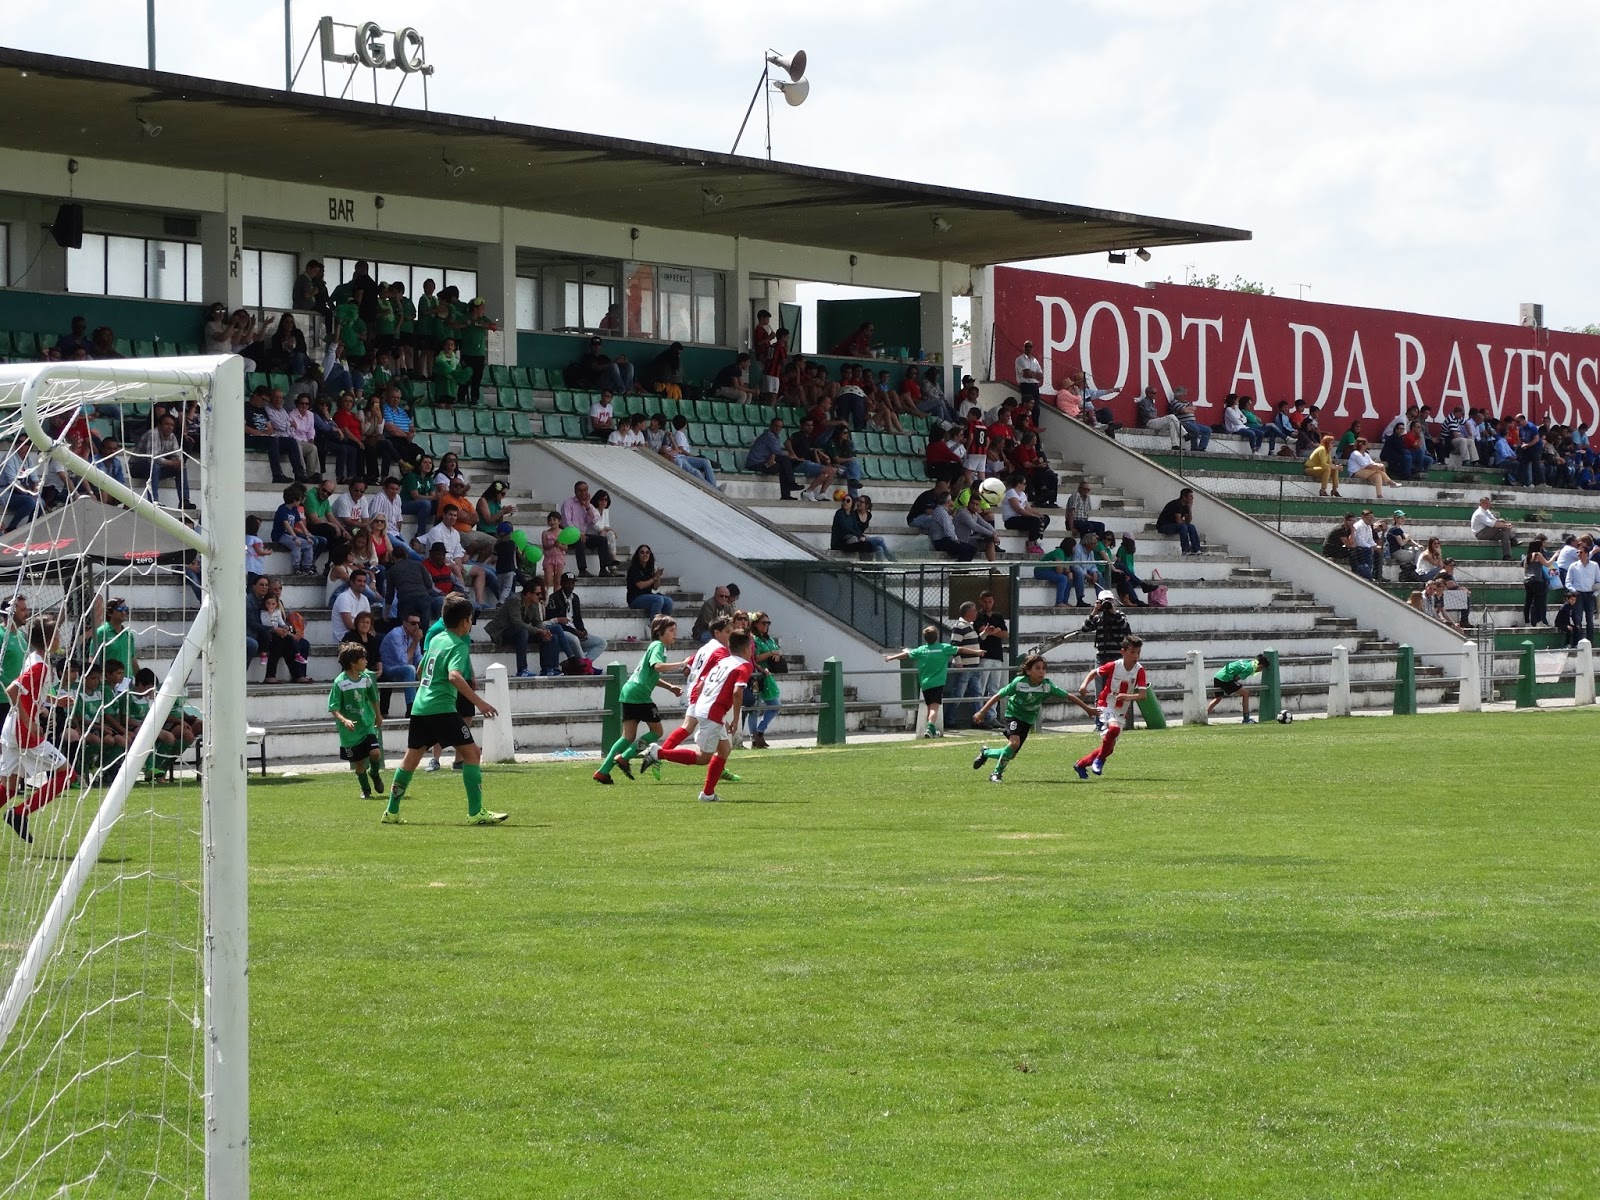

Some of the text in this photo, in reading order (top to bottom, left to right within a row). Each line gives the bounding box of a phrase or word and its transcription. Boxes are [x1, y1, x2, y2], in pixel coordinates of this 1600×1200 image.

[328, 197, 354, 222] BAR
[230, 226, 241, 278] BAR
[1036, 295, 1600, 437] PORTA DA RAVESS
[979, 430, 986, 445] 8
[420, 657, 436, 688] 9
[709, 665, 728, 683] 20
[461, 725, 471, 739] 9
